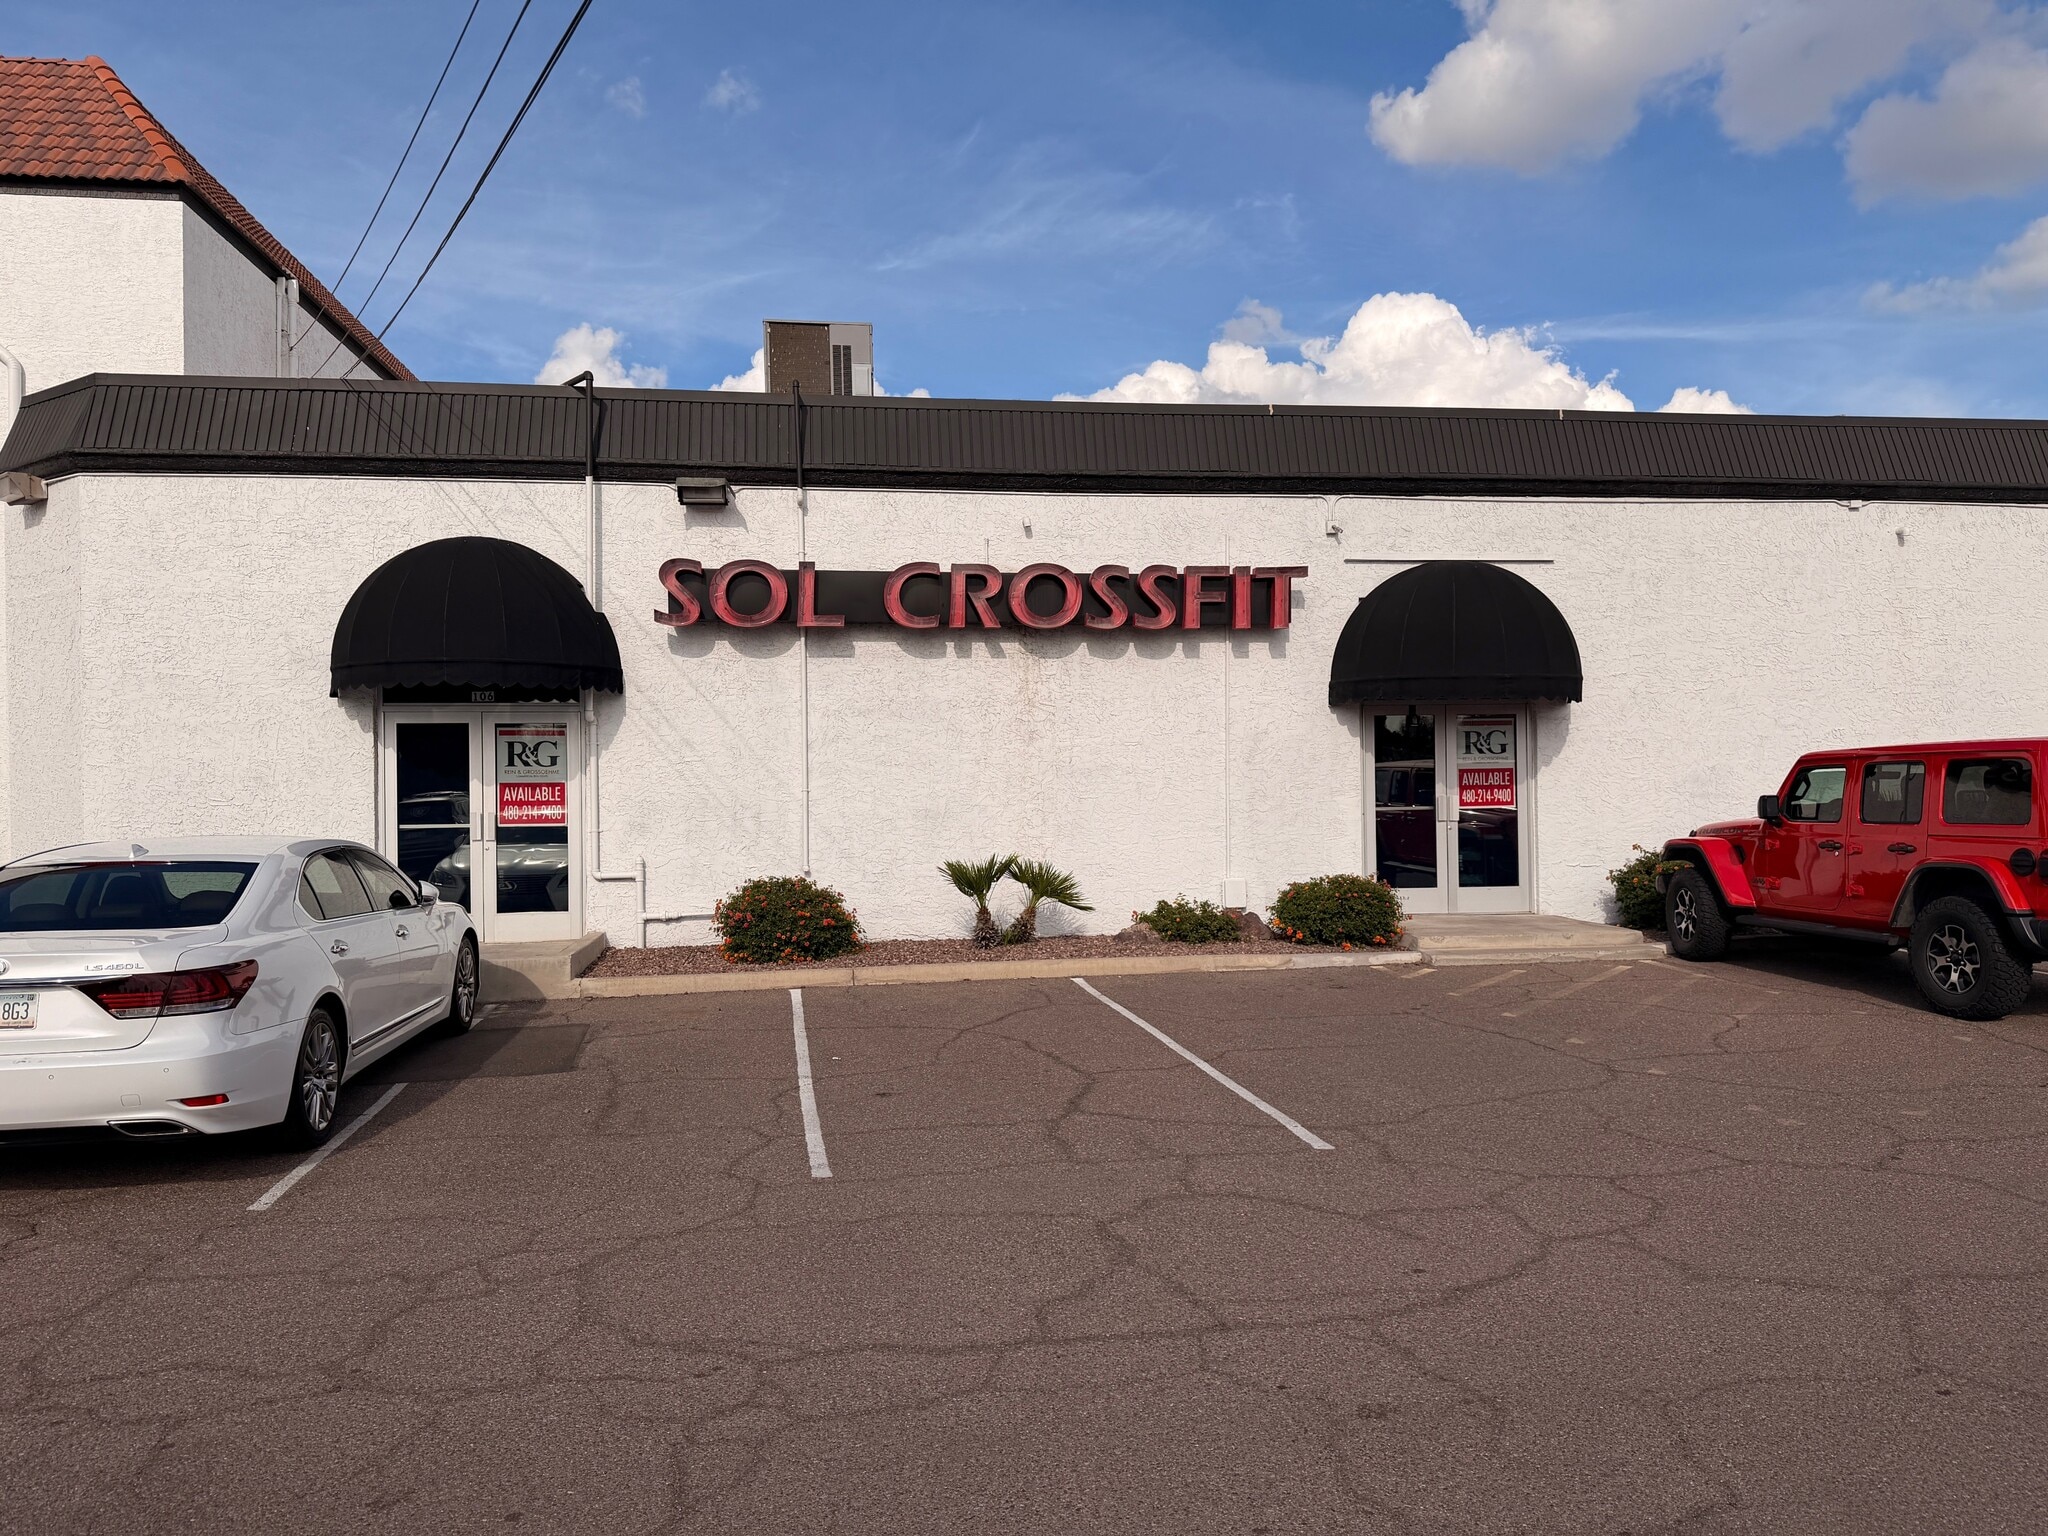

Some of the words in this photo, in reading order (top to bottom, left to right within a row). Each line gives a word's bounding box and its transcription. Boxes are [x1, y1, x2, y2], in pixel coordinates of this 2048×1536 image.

[653, 558, 846, 629] SOL
[883, 561, 1310, 631] CROSSFIT
[473, 692, 494, 702] 106
[1463, 730, 1508, 754] R&G
[504, 740, 561, 768] R&G
[1462, 772, 1510, 785] AVAILABLE
[503, 786, 561, 802] AVAILABLE
[1462, 789, 1511, 802] 480-214-9400
[502, 805, 562, 820] 480-214-9400
[2, 1002, 30, 1021] 8G3
